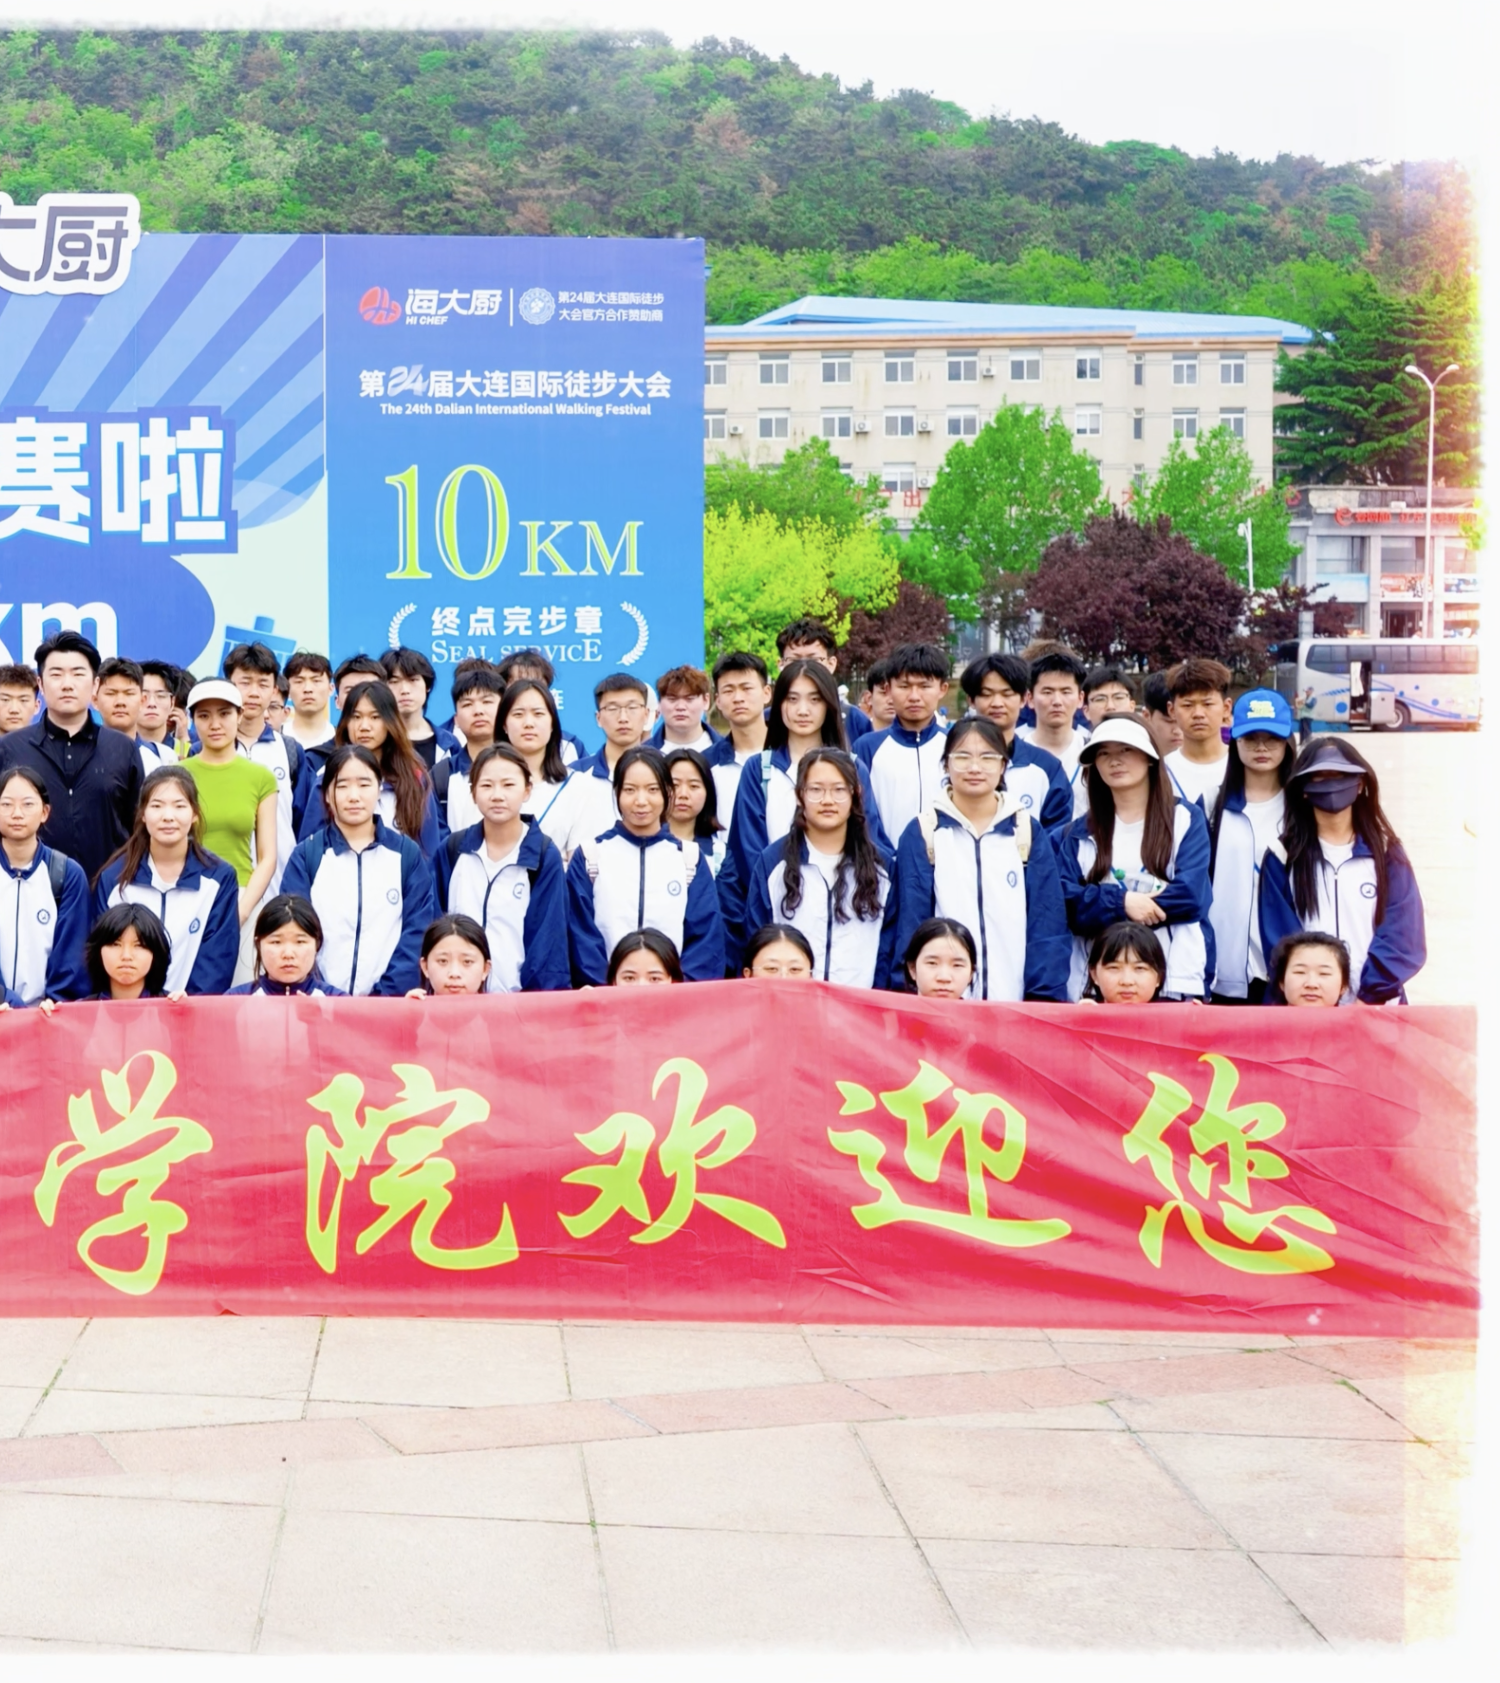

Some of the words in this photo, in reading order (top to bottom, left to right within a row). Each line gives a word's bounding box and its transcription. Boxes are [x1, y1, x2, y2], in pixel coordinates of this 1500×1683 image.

[405, 289, 503, 316] 海大厨
[558, 291, 665, 305] 第24届大连国际徒步
[406, 316, 418, 325] HI
[419, 316, 448, 325] CHEF
[559, 308, 663, 322] 大会官方合作赞助商
[359, 364, 672, 399] 第24届大连国际徒步大会
[380, 403, 403, 415] The
[405, 403, 432, 415] 24th
[435, 403, 473, 415] Dalian
[475, 403, 553, 415] International
[555, 403, 603, 418] Walking
[605, 403, 652, 416] Festival
[431, 605, 603, 636] 终点完步章
[431, 639, 494, 664] SEAL
